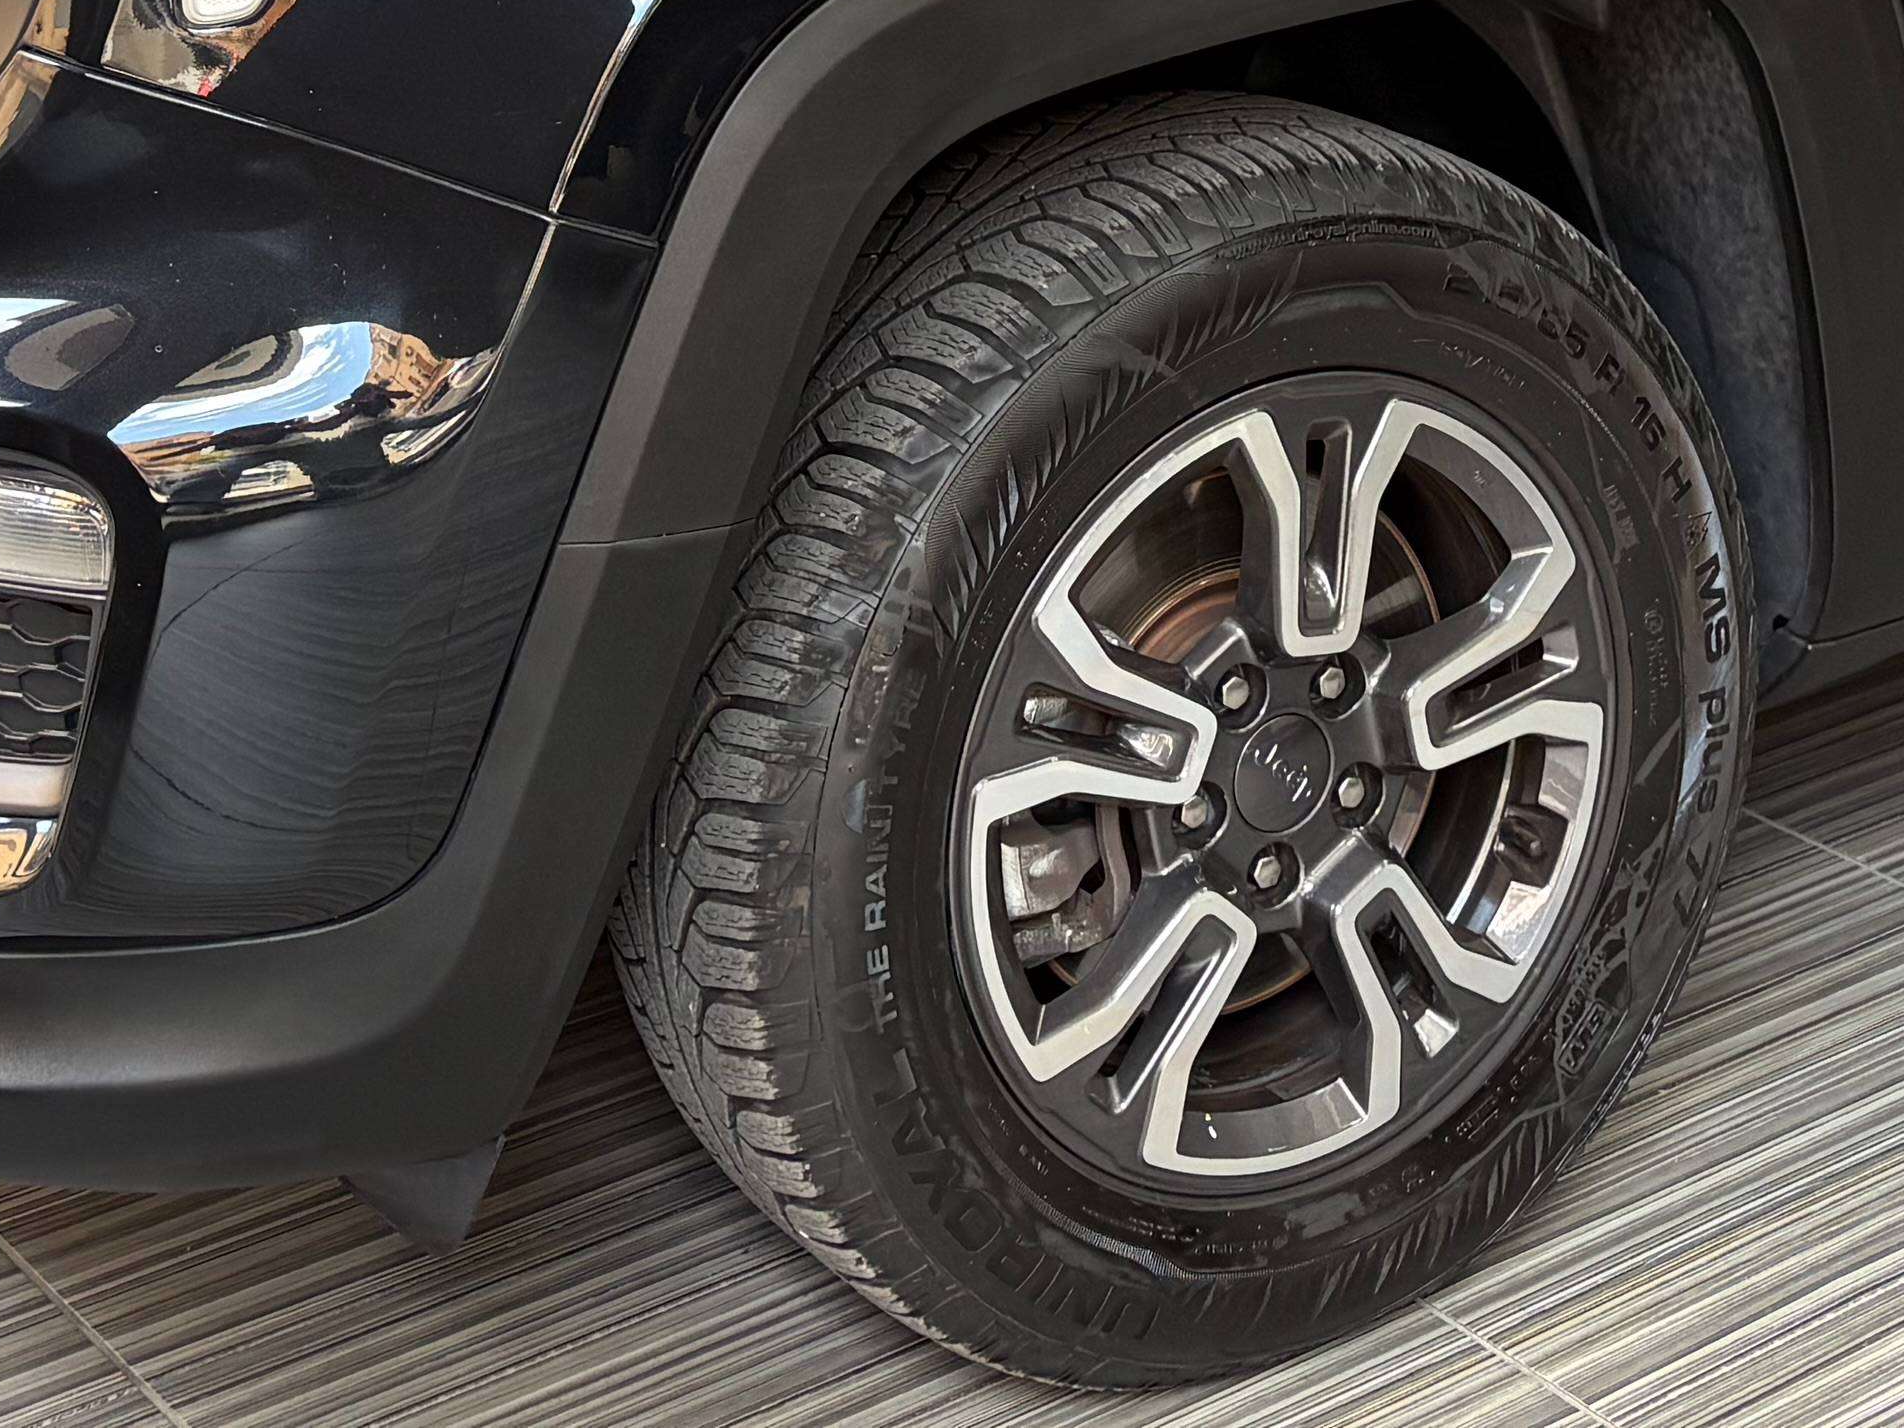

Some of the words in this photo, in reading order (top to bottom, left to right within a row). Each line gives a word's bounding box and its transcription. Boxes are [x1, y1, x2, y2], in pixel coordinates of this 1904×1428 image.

[1662, 456, 1693, 504] H
[1694, 552, 1732, 665] MS
[1696, 685, 1731, 815] plus
[865, 944, 899, 1035] THE
